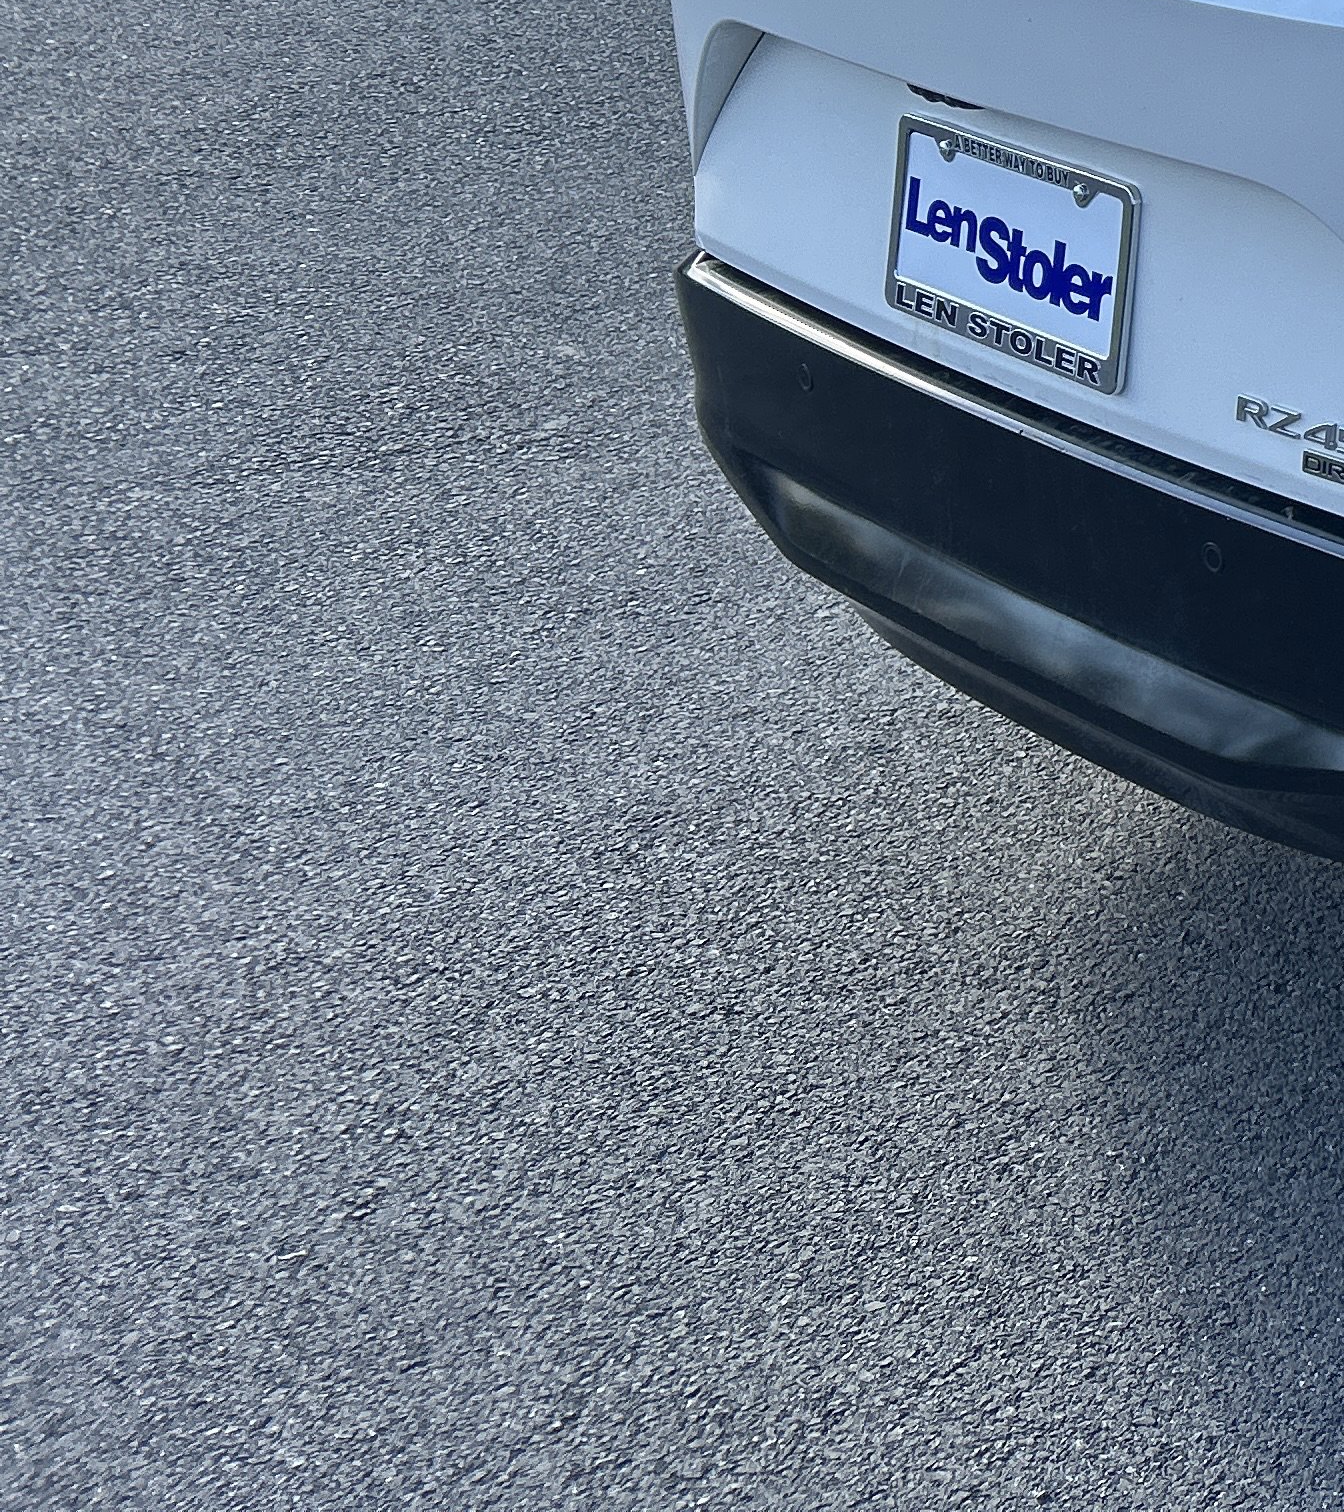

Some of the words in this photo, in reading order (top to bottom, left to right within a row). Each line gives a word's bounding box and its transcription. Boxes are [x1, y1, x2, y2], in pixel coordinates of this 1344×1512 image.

[954, 134, 962, 151] A
[963, 138, 1003, 164] BETTER
[1004, 150, 1028, 173] WAY
[1029, 159, 1045, 179] TO
[1047, 165, 1070, 187] BUY
[895, 283, 960, 328] LEN
[967, 311, 1101, 387] STOLER
